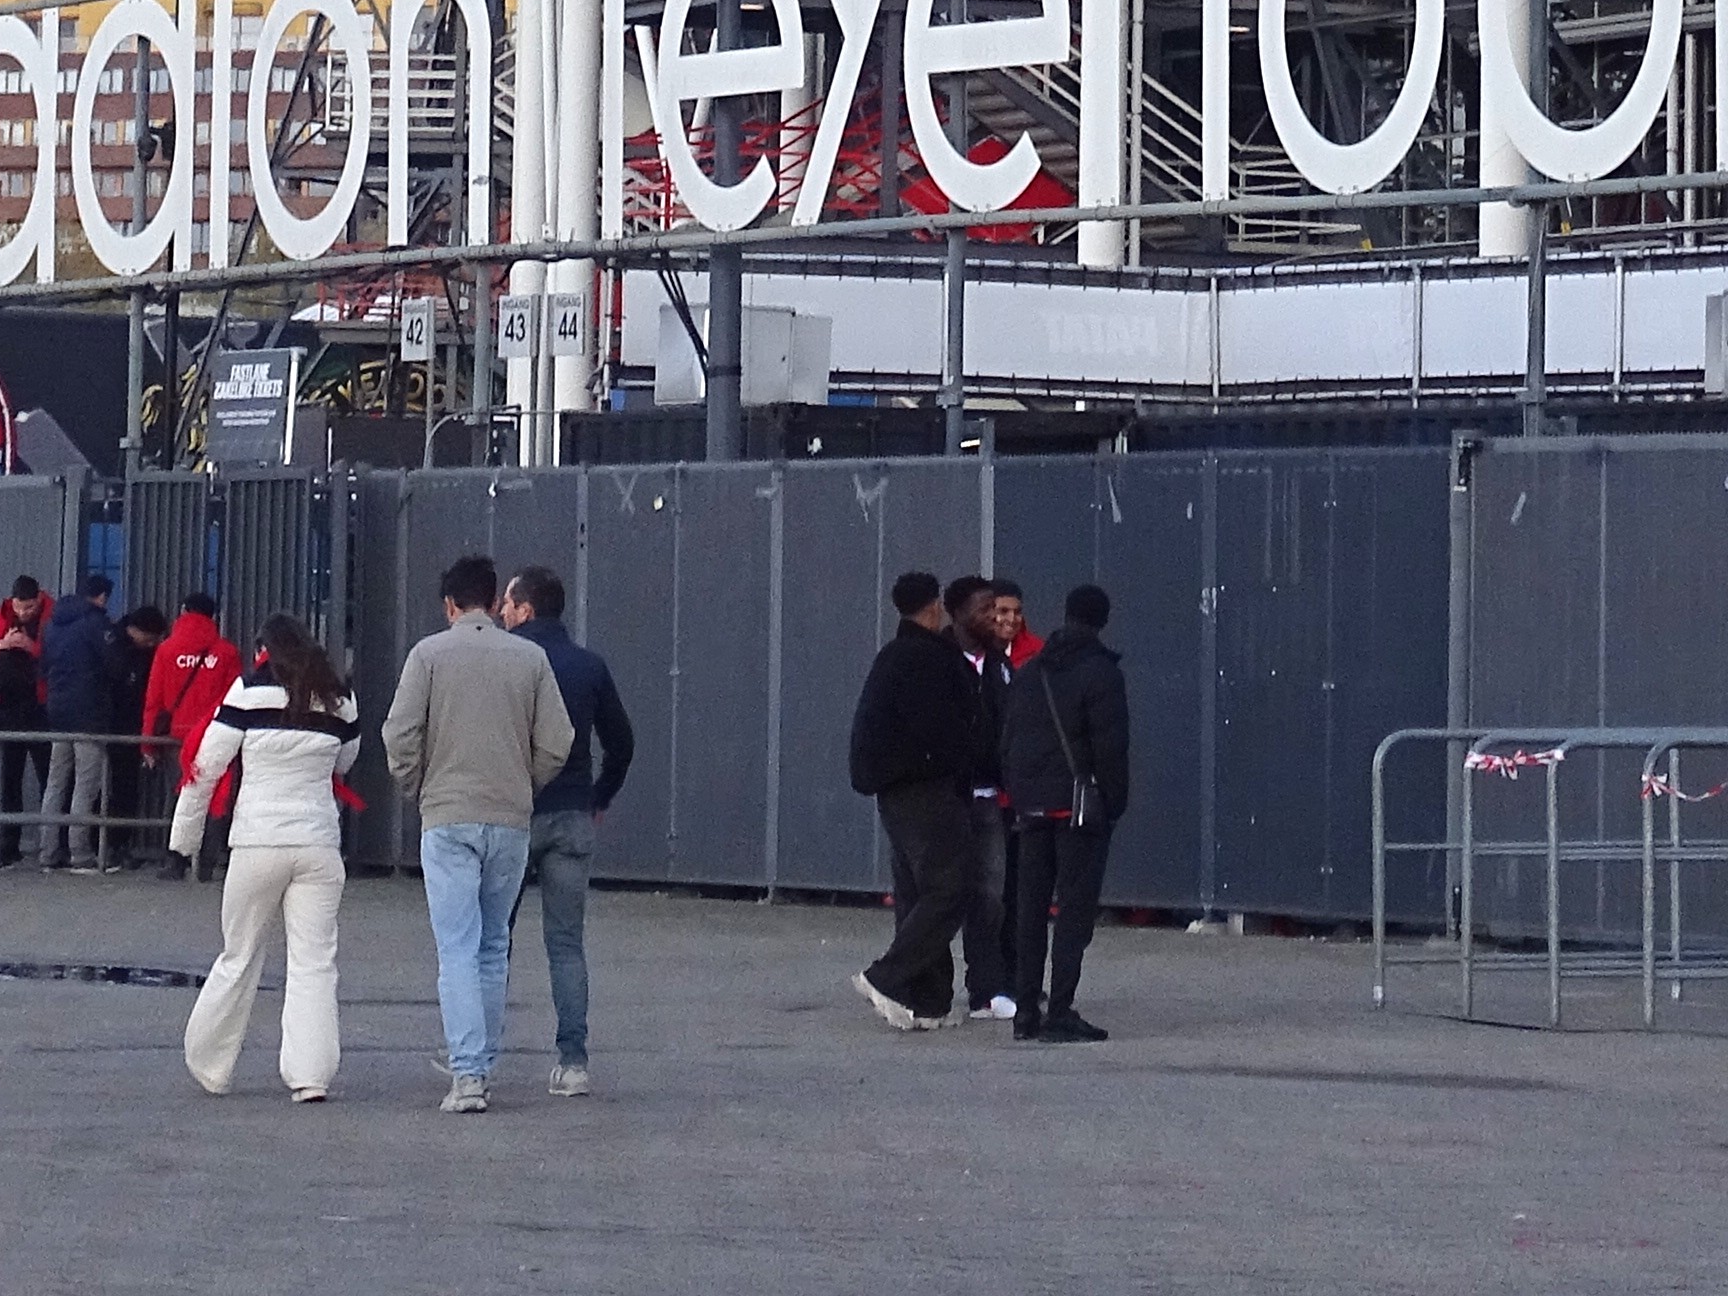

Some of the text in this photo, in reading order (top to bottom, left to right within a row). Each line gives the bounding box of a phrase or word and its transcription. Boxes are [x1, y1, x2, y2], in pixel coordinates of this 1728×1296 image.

[406, 317, 424, 347] 42
[505, 313, 526, 342] 43
[558, 311, 578, 340] 44
[176, 654, 218, 669] CRW
